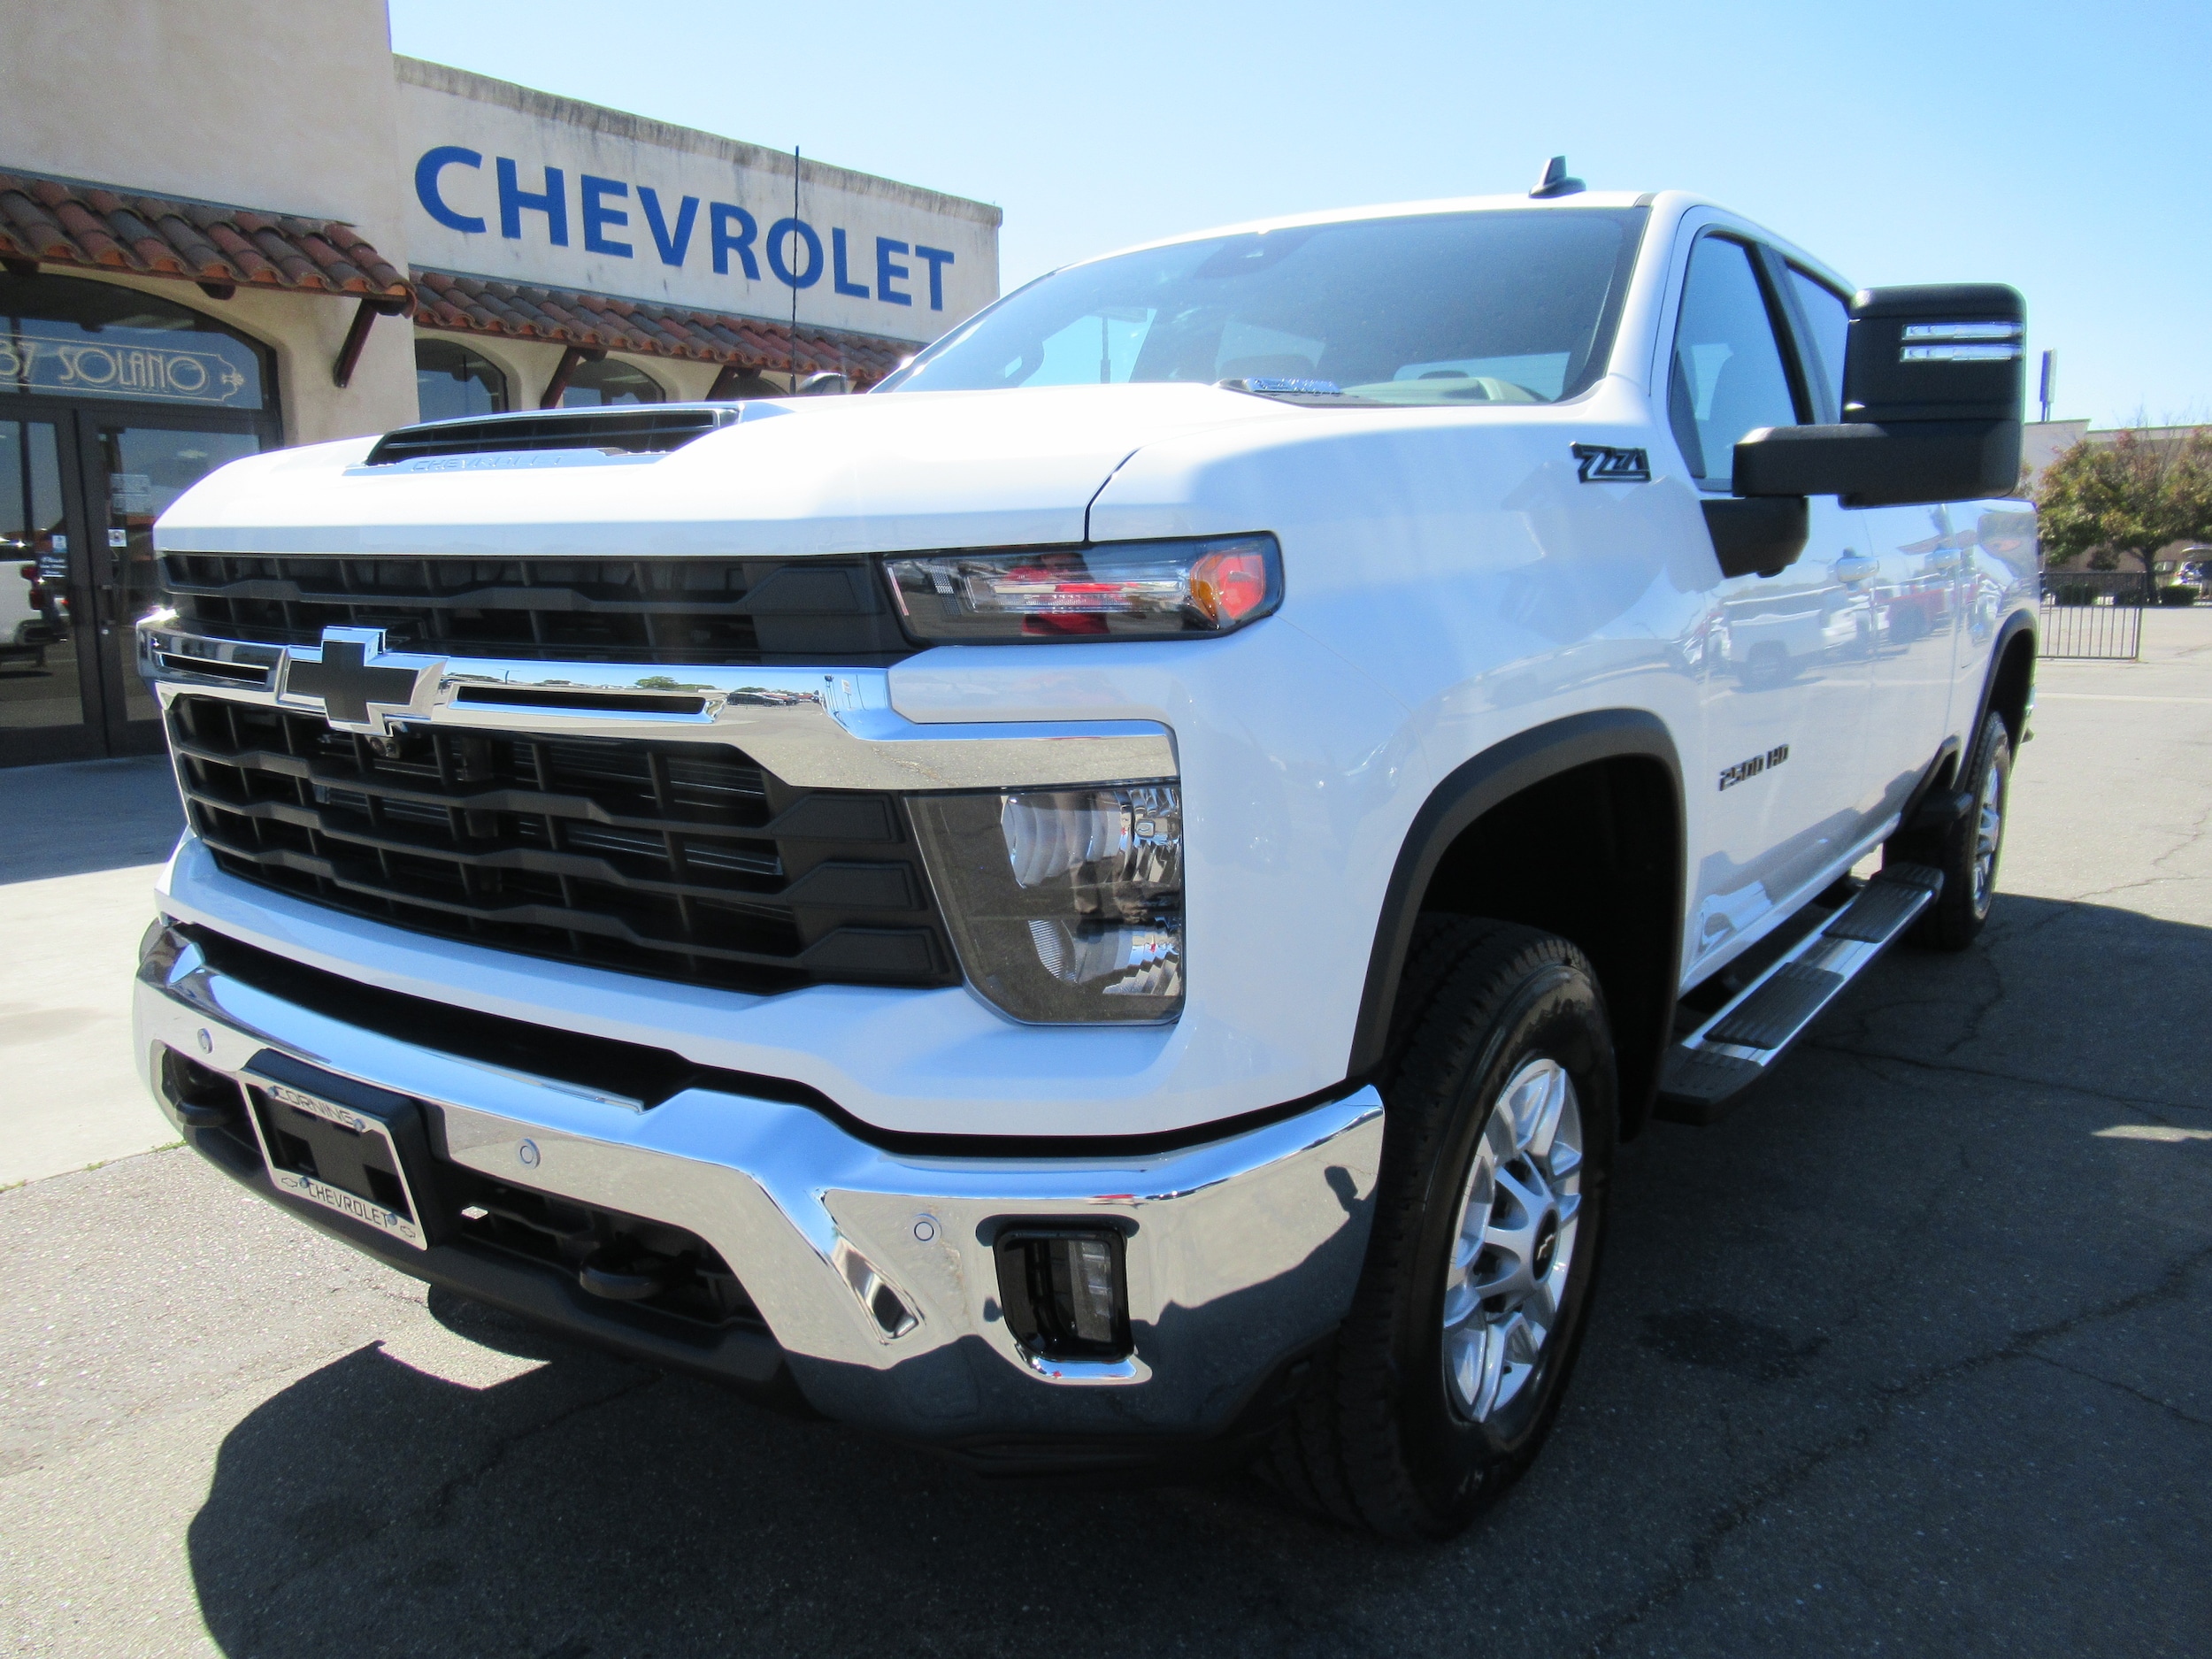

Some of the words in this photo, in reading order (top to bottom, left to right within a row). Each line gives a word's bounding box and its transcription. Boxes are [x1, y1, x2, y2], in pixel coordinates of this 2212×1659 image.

[414, 145, 955, 311] CHEVROLET
[57, 346, 207, 390] SOLANO
[307, 1181, 389, 1228] CHEVROLET
